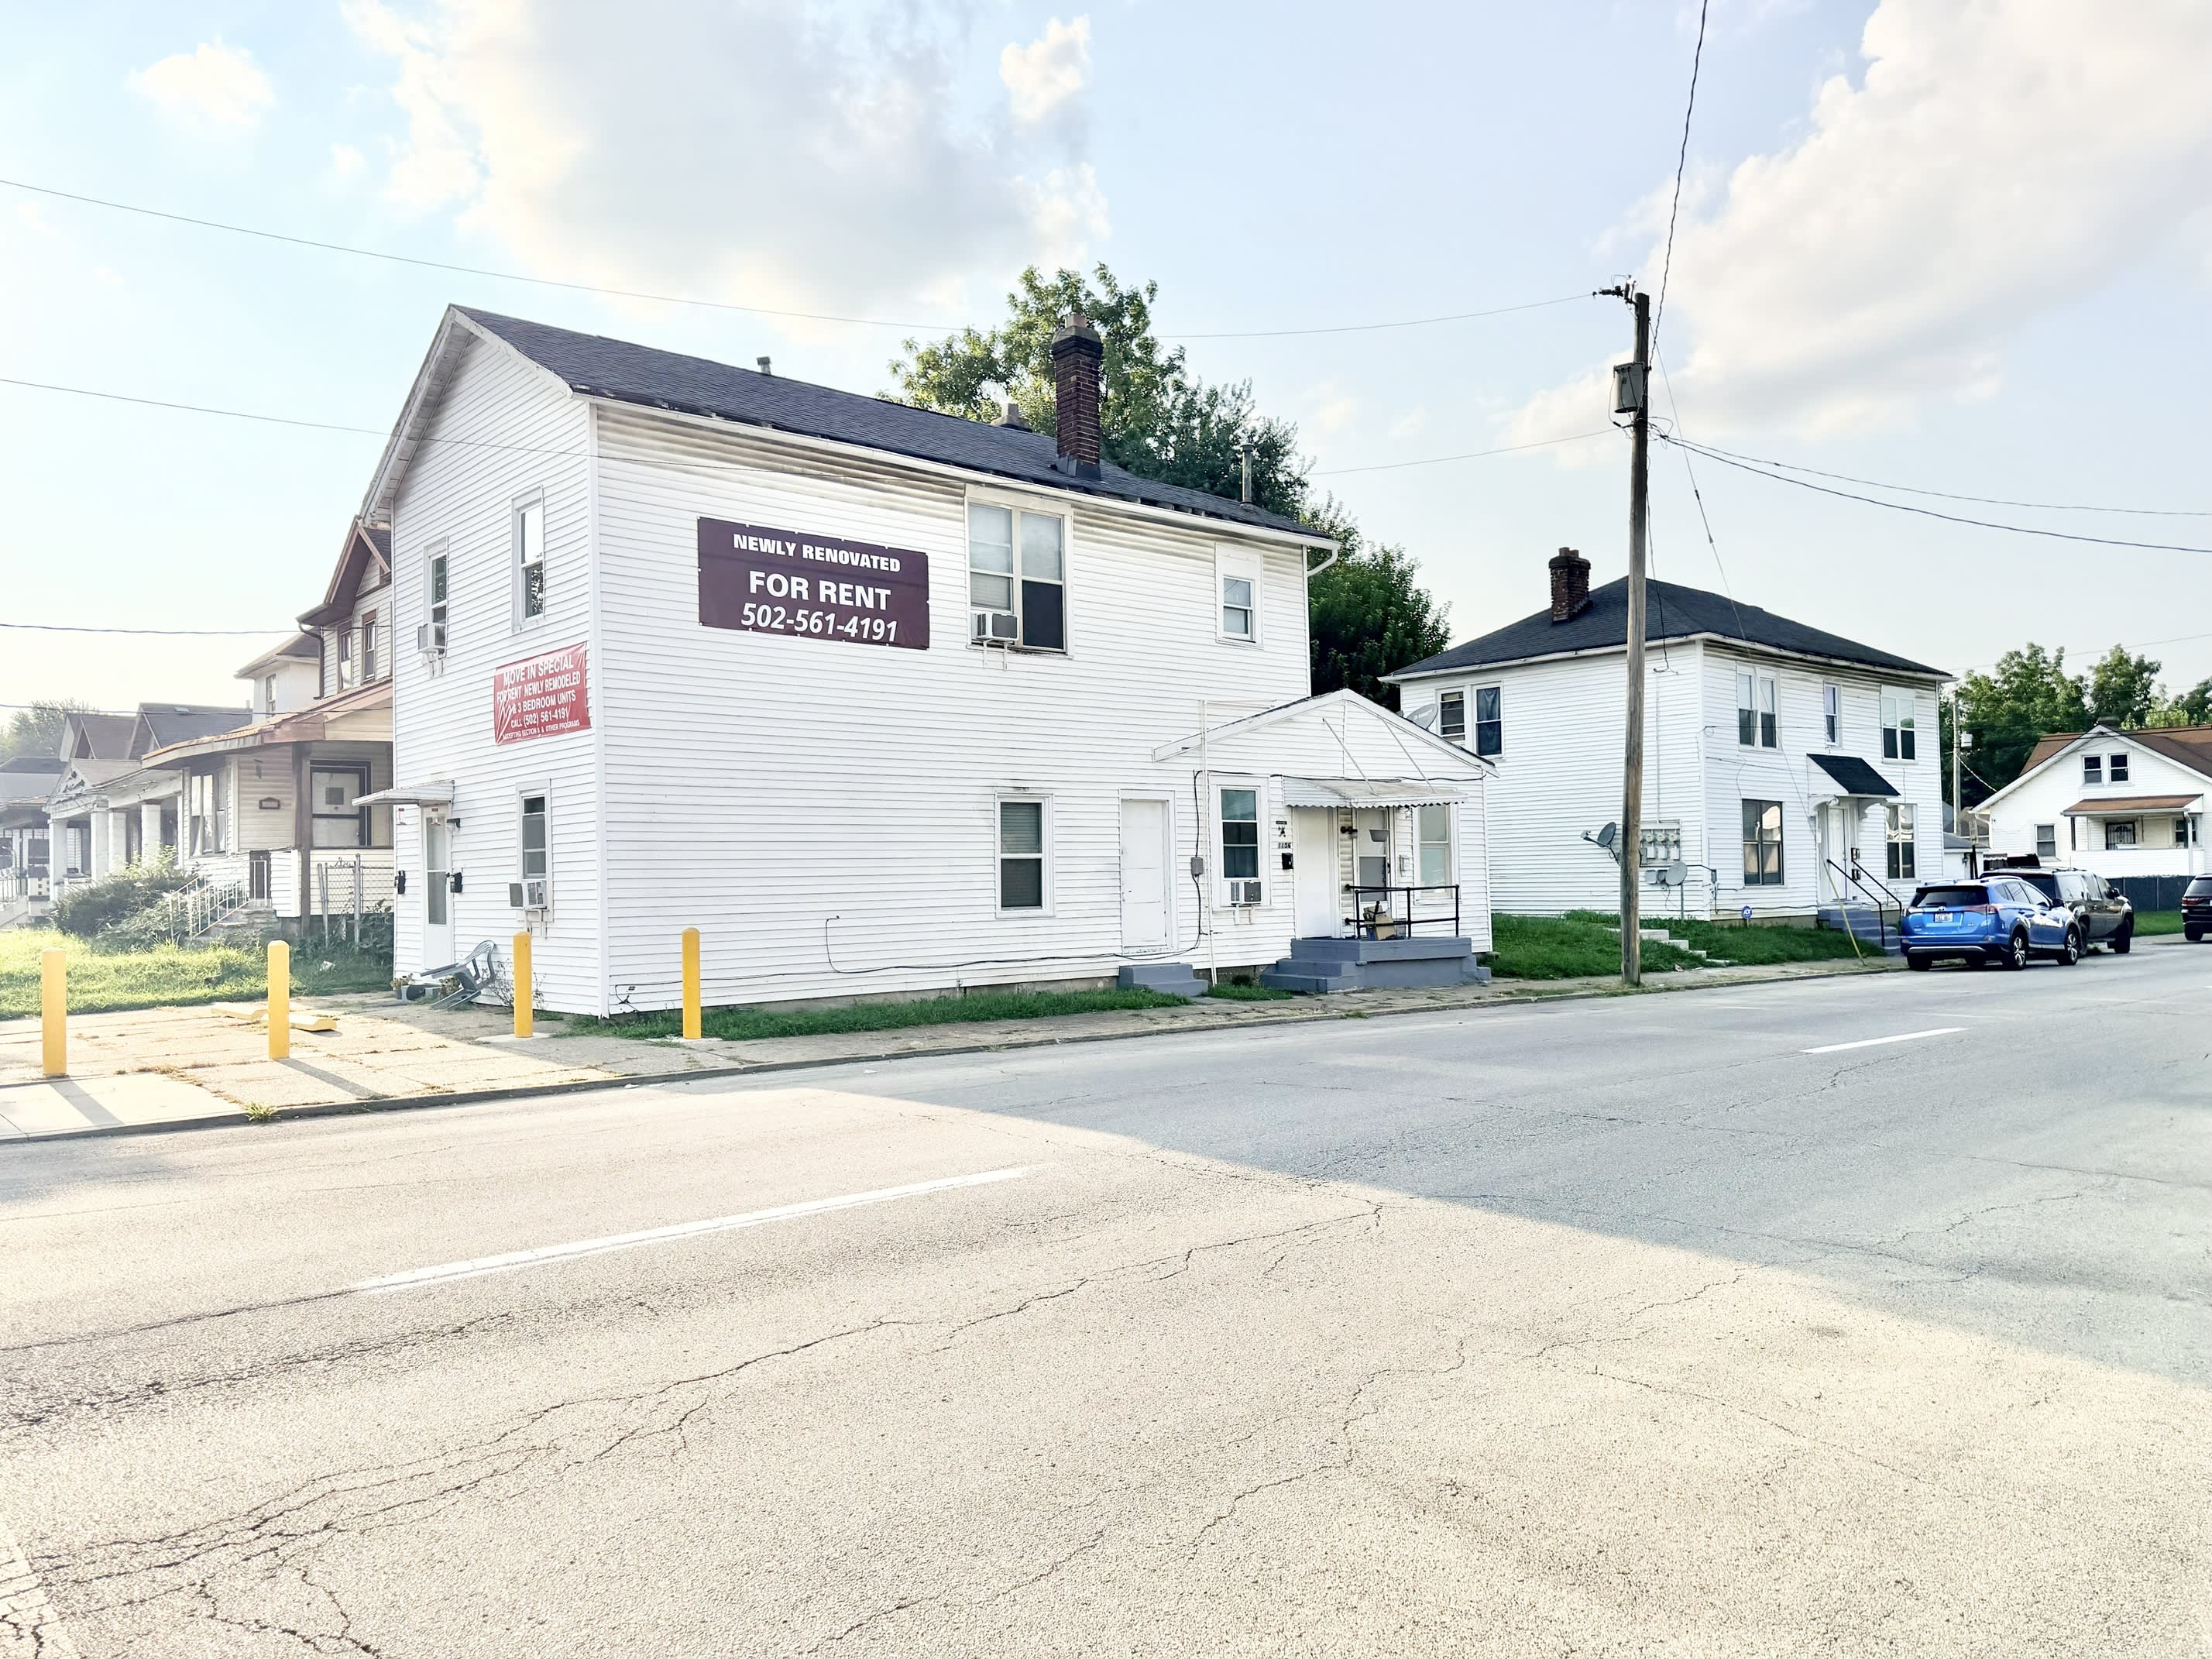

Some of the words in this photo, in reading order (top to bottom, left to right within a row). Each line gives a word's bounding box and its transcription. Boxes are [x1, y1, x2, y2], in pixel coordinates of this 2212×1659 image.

[733, 534, 796, 556] NEWLY
[802, 545, 901, 572] RENOVATED
[749, 570, 809, 600] FOR
[819, 580, 891, 610] RENT
[740, 603, 898, 642] 502-561-4191
[503, 668, 525, 685] MOVE
[527, 665, 536, 679] IN
[538, 654, 574, 677] SPECIAL
[524, 681, 544, 697] NEWLY
[545, 671, 581, 692] REMODELED
[517, 702, 522, 713] 3
[523, 695, 556, 712] BEDROOM
[558, 689, 576, 705] UNITS
[511, 718, 522, 728] CALL
[523, 712, 539, 728] (502)
[541, 707, 568, 723] 561-4191
[559, 720, 580, 729] PROGRAMS
